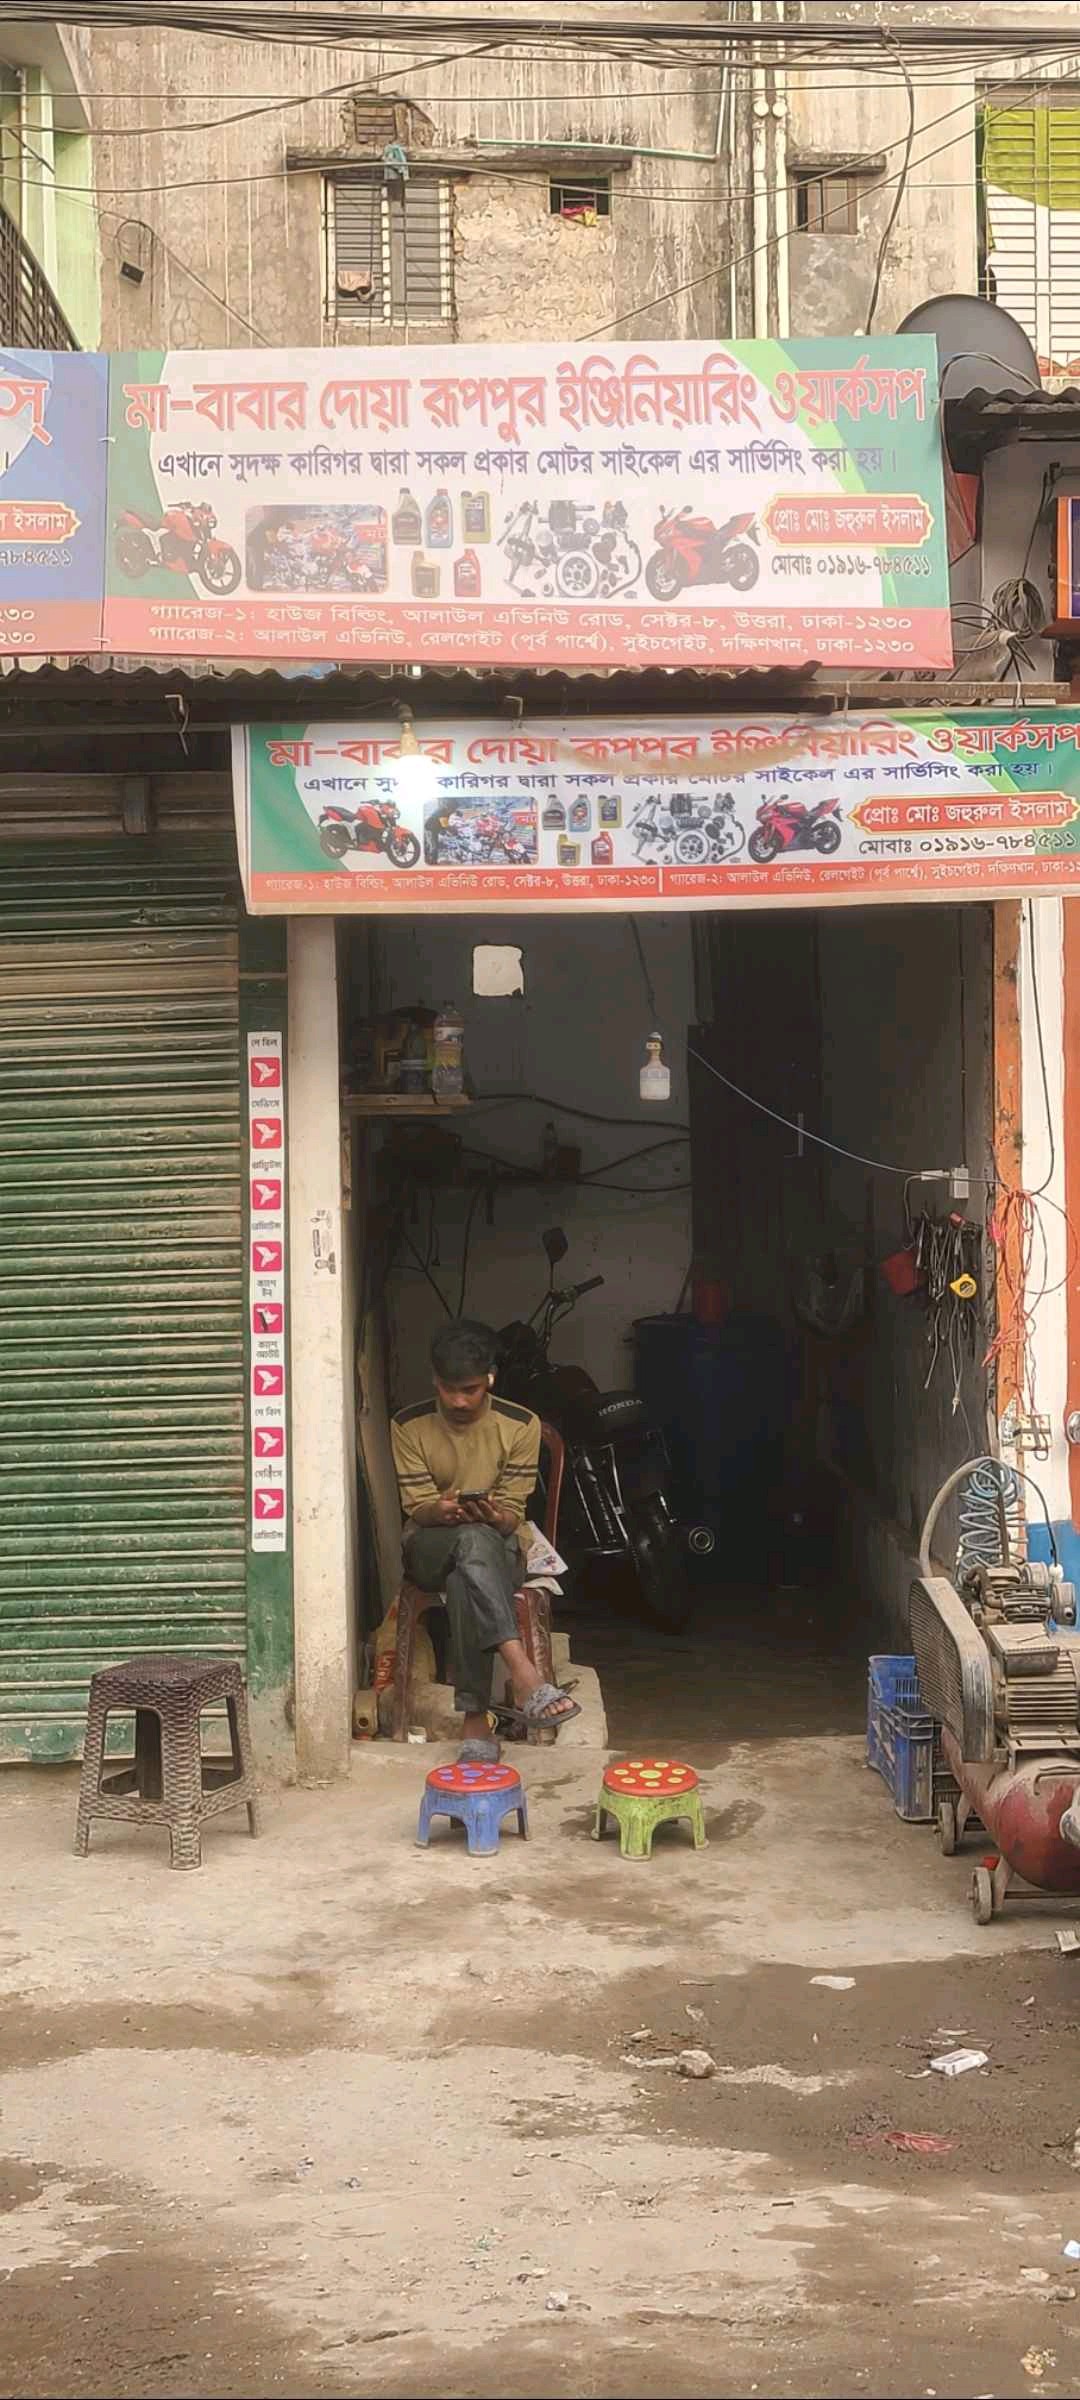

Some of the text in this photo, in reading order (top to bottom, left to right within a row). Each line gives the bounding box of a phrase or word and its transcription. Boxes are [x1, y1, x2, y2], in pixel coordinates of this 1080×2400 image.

[123, 352, 927, 446] মা-বাবার দোয়া রূপপুর ইঞ্জিনিয়ারিং ওয়ার্কসপ
[158, 451, 223, 478] এখানে
[228, 453, 283, 483] সুদক্ষ
[287, 444, 363, 476] কারিগর
[369, 448, 410, 476] দ্বারা
[415, 450, 468, 475] সকল
[473, 448, 530, 476] প্রকার
[537, 442, 595, 476] মোটর
[600, 442, 682, 478] সাইকেল
[689, 449, 721, 474] এর
[727, 438, 806, 476] সার্ভিসিং
[808, 446, 850, 473] করা
[853, 447, 884, 473] হয়
[14, 506, 68, 533] ইসলাম
[880, 503, 925, 533] ইসলাম
[265, 605, 323, 623] হাউজ
[400, 607, 485, 625] আলাউল
[494, 606, 572, 626] এভিনিউ
[254, 627, 329, 645] আলাউল
[467, 736, 560, 767] দোয়া
[304, 776, 369, 792] এখানে
[436, 771, 511, 790] কারিগর
[518, 773, 559, 789] দ্বারা
[564, 773, 615, 788] সকল
[754, 766, 837, 784] সাইকেল
[843, 767, 877, 782] এর
[882, 760, 961, 781] সার্ভিসিং
[965, 763, 1003, 778] করা
[1010, 762, 1040, 777] হয়
[863, 798, 1070, 825] প্রোঃ মোঃ জহুরুল ইসলাম
